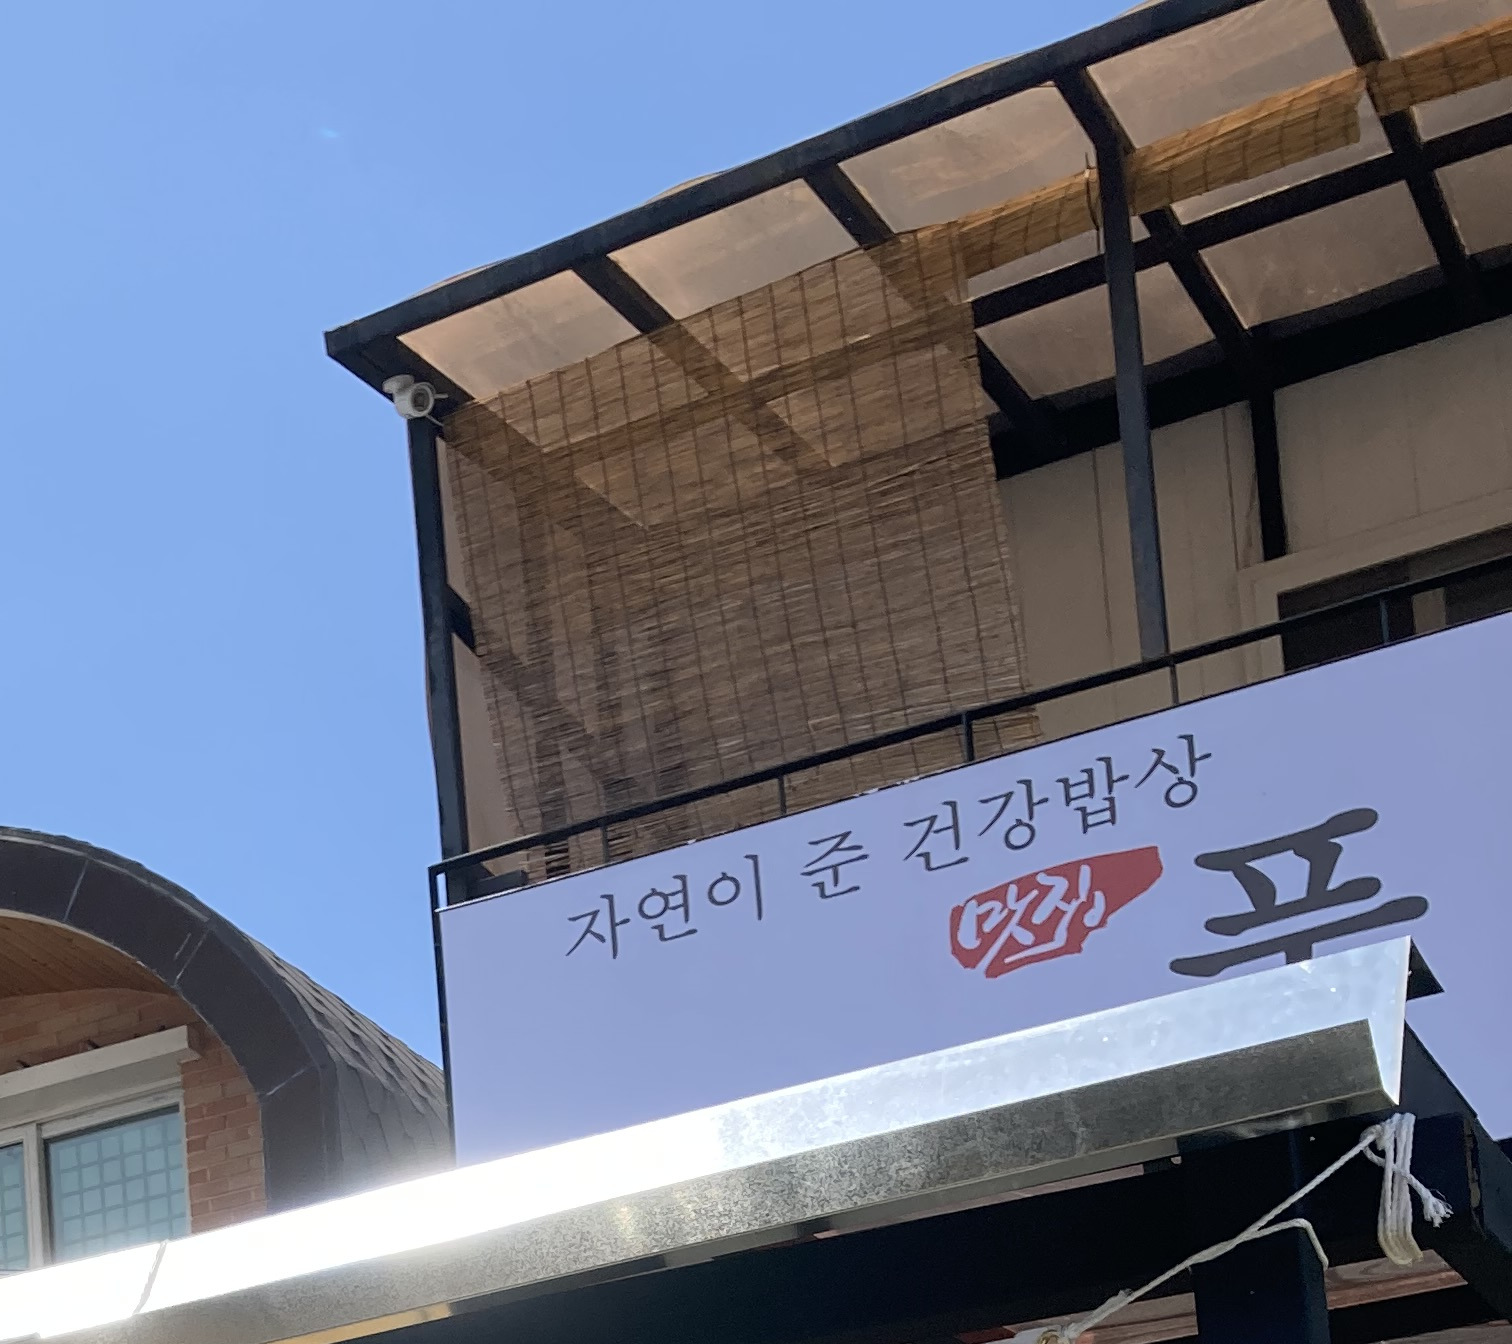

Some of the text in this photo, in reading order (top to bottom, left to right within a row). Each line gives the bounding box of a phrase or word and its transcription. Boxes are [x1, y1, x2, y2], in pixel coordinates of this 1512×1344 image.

[565, 734, 1212, 960] 자연이 준 건강밥상
